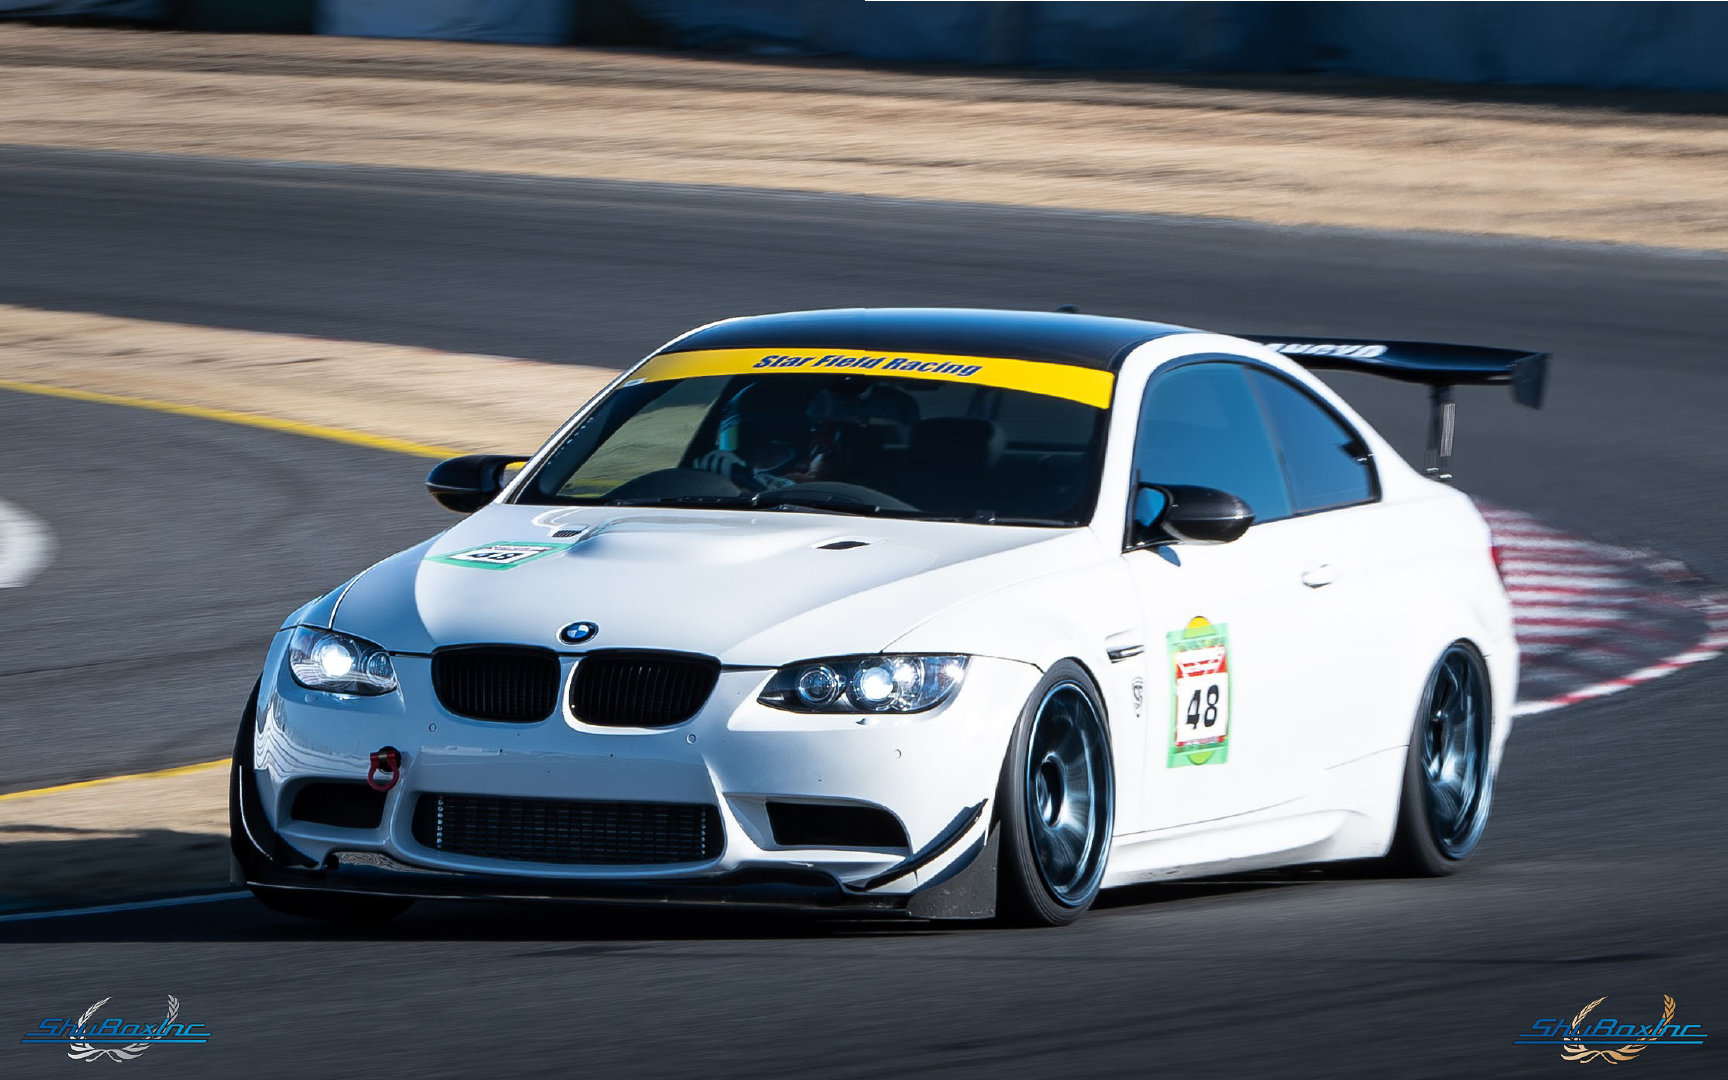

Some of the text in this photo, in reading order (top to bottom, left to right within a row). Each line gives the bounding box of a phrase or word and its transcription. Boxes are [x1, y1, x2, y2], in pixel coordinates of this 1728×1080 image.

[753, 355, 983, 377] Star Field Racing
[468, 552, 524, 561] 48
[1185, 684, 1220, 730] 48
